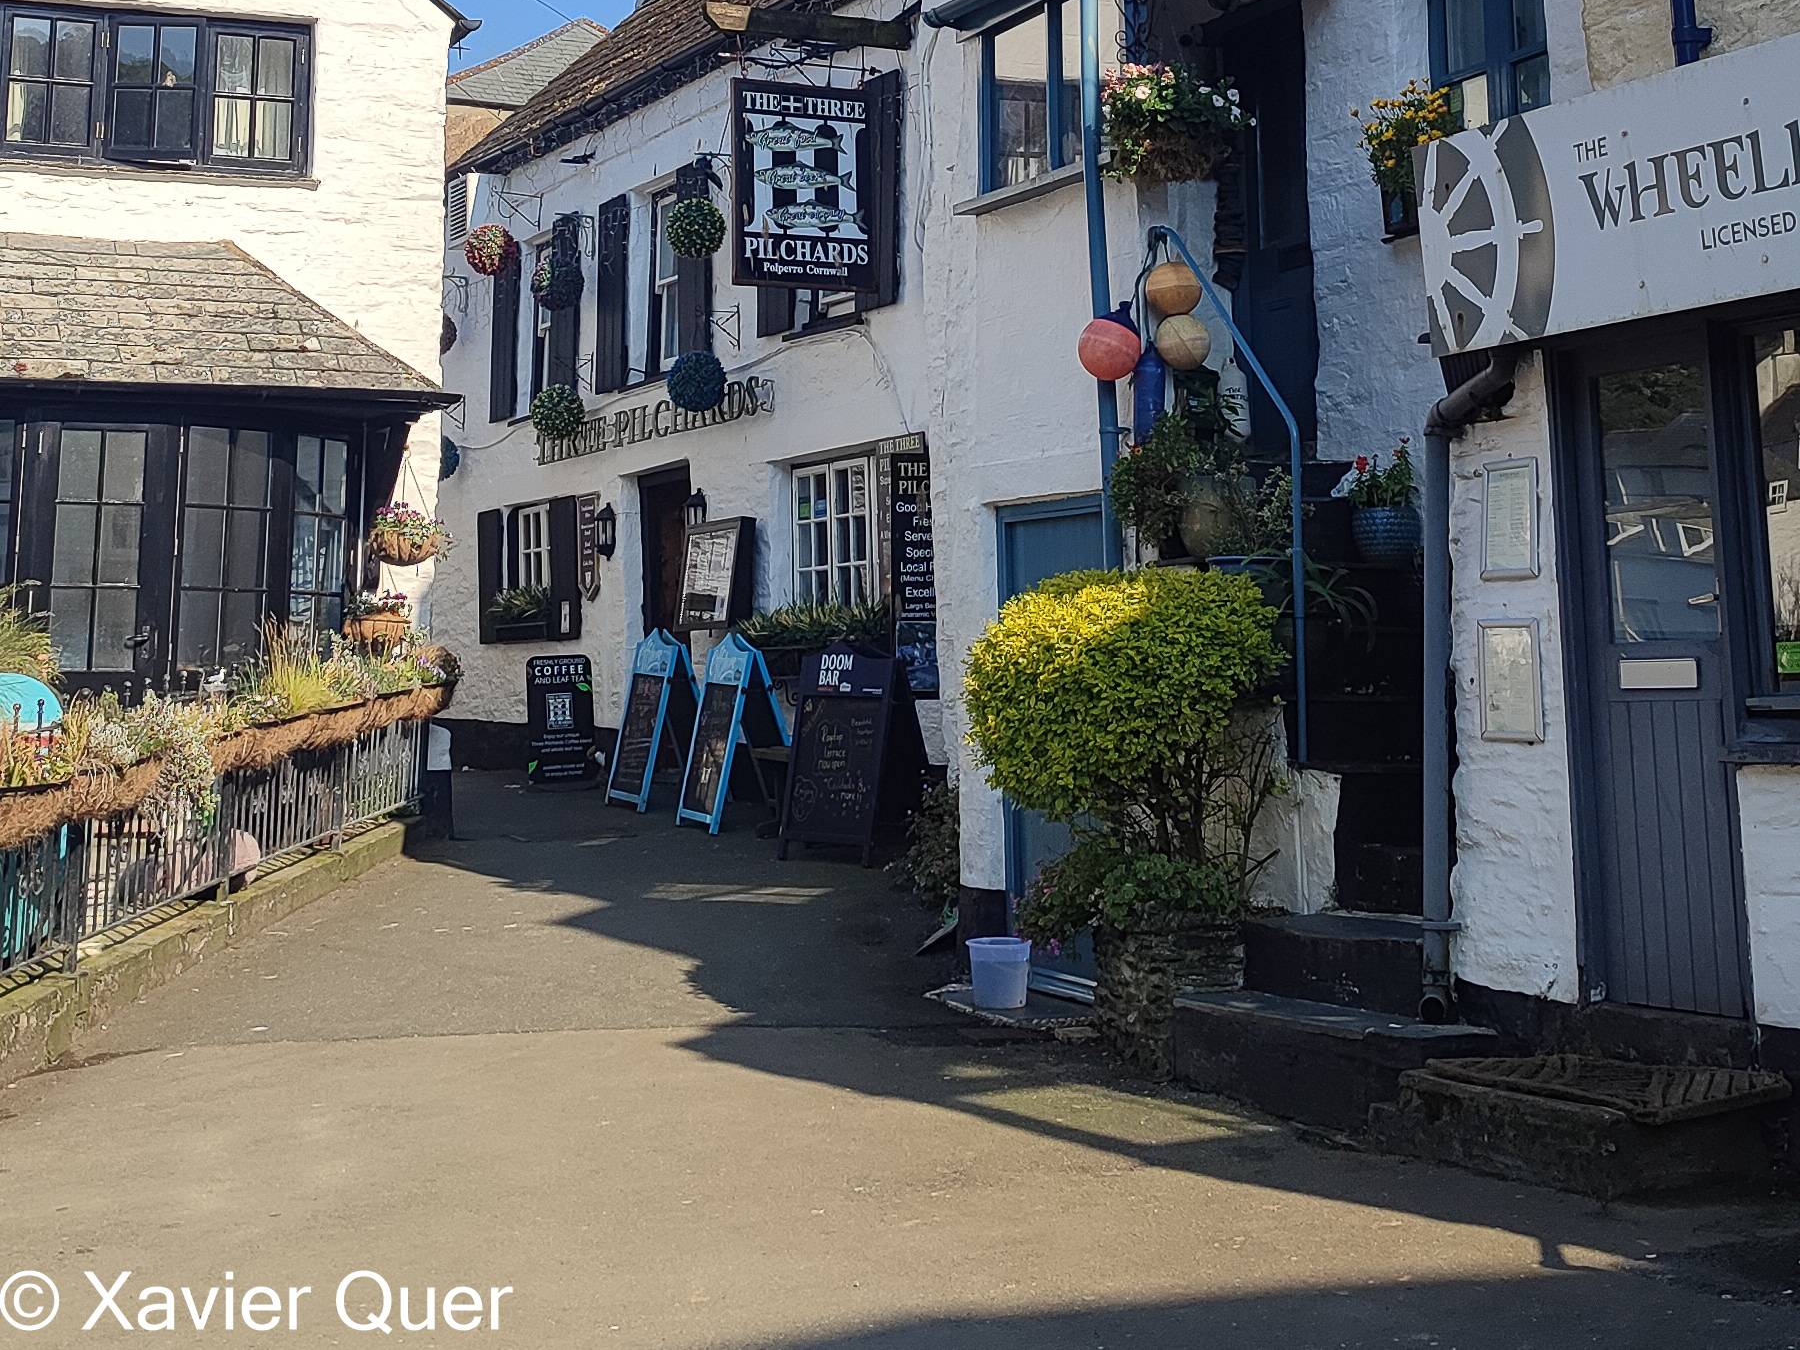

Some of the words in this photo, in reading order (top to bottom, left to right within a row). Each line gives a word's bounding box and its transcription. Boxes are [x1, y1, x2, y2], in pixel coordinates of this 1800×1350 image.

[742, 91, 780, 111] THE
[804, 97, 866, 119] THREE
[758, 132, 792, 150] Great
[794, 130, 819, 148] food
[1573, 136, 1608, 163] THE
[1701, 212, 1796, 250] LICENSED
[744, 237, 868, 265] PILCHARDS
[763, 262, 804, 275] Polperro
[806, 264, 849, 277] Cornwall
[879, 440, 894, 454] THE
[895, 435, 920, 451] THREE
[898, 462, 928, 477] THE
[900, 561, 927, 573] Local
[534, 664, 584, 676] COFFEE
[820, 654, 854, 671] DOOM
[534, 676, 551, 685] AND
[552, 675, 570, 684] LEAF
[571, 674, 585, 683] TEA
[818, 670, 840, 686] BAR
